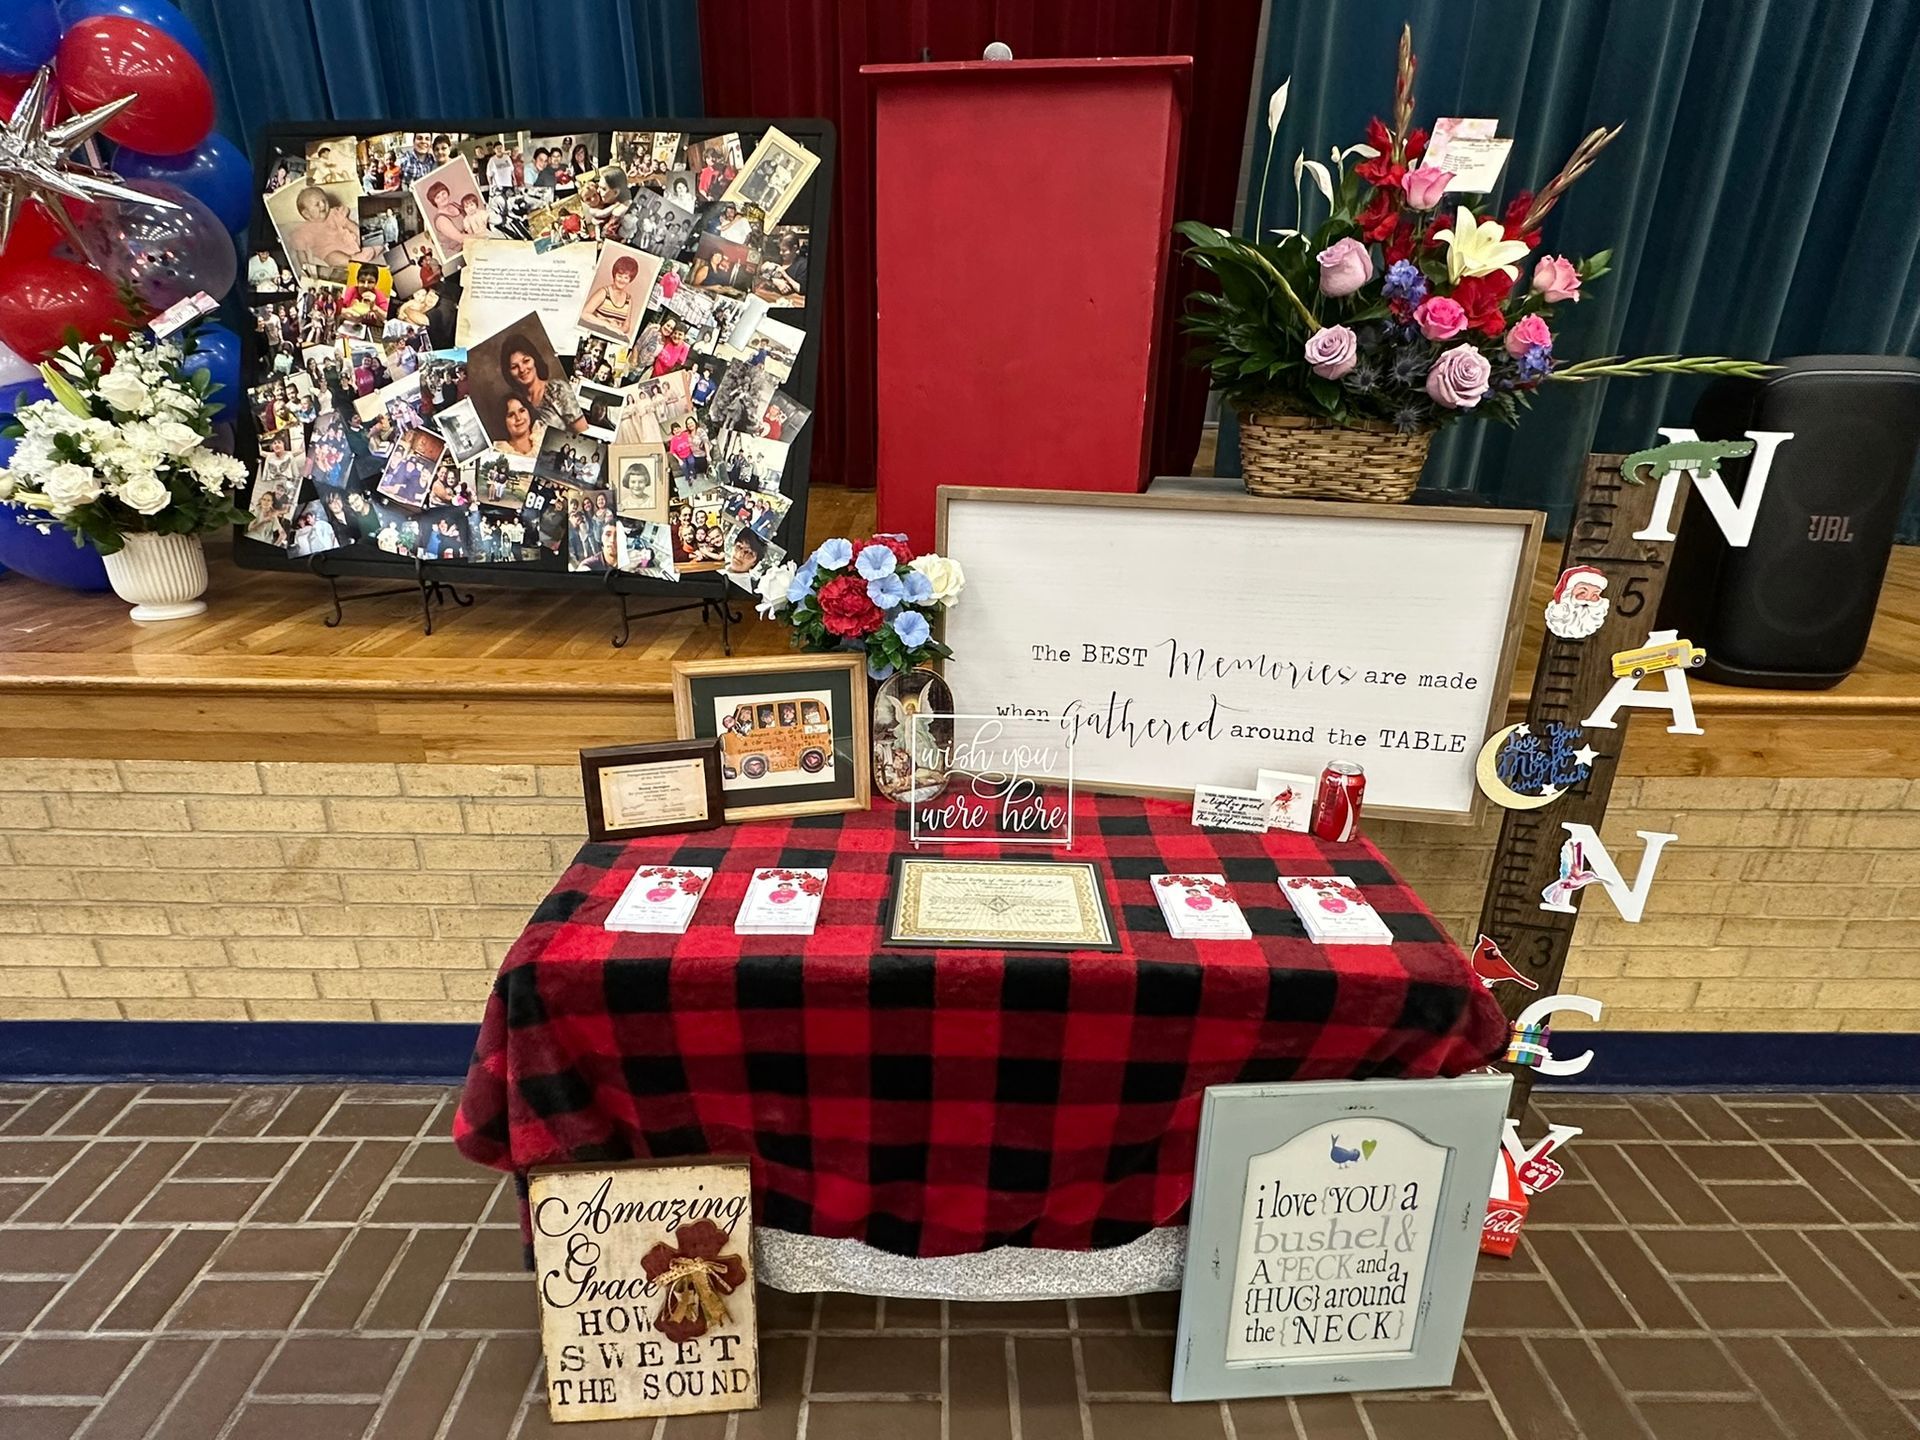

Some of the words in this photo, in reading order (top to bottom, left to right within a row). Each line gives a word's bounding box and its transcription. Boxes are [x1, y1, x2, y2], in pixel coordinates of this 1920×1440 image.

[525, 491, 546, 511] 88
[1808, 515, 1854, 542] JBL
[1616, 577, 1649, 618] 5
[1032, 644, 1071, 662] The
[1081, 643, 1148, 667] BEST
[1155, 638, 1357, 689] Memories
[1364, 670, 1407, 686] are
[1418, 672, 1478, 690] made
[997, 704, 1050, 722] when
[1230, 724, 1315, 743] around
[1327, 728, 1367, 747] the
[1379, 729, 1466, 753] TABLE
[1546, 722, 1582, 740] You
[922, 720, 1003, 770] wish
[970, 745, 1058, 799] you
[922, 795, 988, 831] were
[1003, 779, 1066, 832] here
[1529, 936, 1554, 968] 3
[535, 1177, 747, 1237] Amazing
[1256, 1184, 1266, 1219] i
[1270, 1180, 1317, 1218] love
[1400, 1181, 1419, 1211] a
[1253, 1214, 1391, 1255] bushel
[1394, 1213, 1417, 1253] &
[1482, 1208, 1524, 1234] Cola
[543, 1233, 660, 1308] Grace
[1248, 1259, 1272, 1285] A
[1277, 1253, 1354, 1282] PECK
[1356, 1249, 1388, 1274] and
[1387, 1261, 1401, 1283] a
[1324, 1272, 1409, 1309] around
[577, 1306, 652, 1337] HOW
[1245, 1318, 1275, 1343] the
[560, 1335, 740, 1372] SWEET
[553, 1378, 617, 1405] THE
[643, 1368, 751, 1400] SOUND
